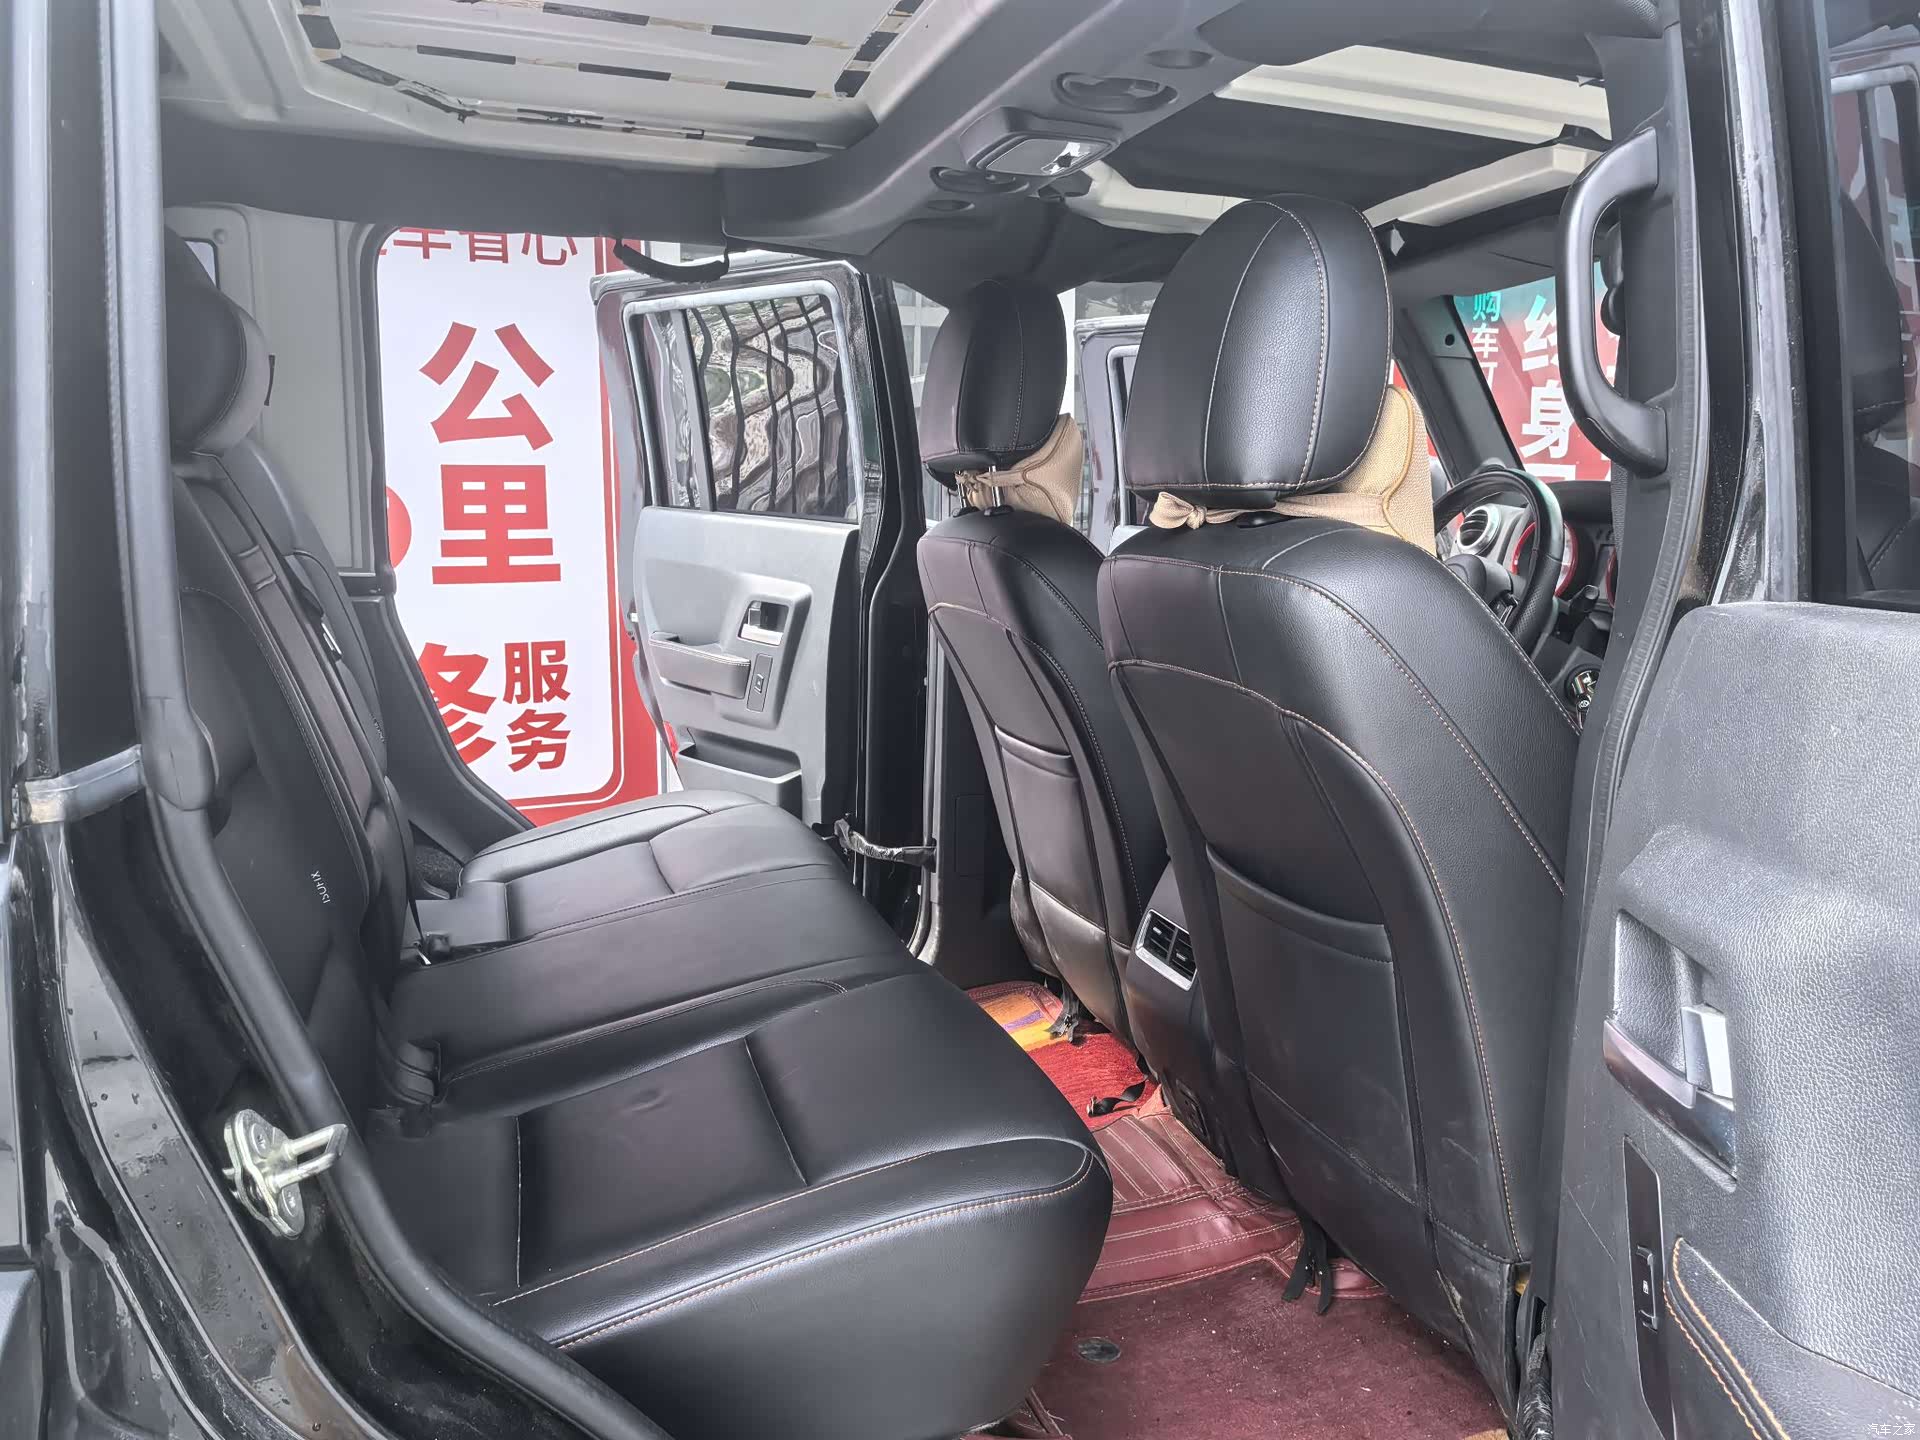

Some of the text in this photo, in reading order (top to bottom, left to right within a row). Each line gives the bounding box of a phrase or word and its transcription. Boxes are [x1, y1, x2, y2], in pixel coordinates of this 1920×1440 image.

[380, 227, 578, 265] 车省心
[419, 321, 561, 584] 公里
[501, 640, 571, 772] 服务
